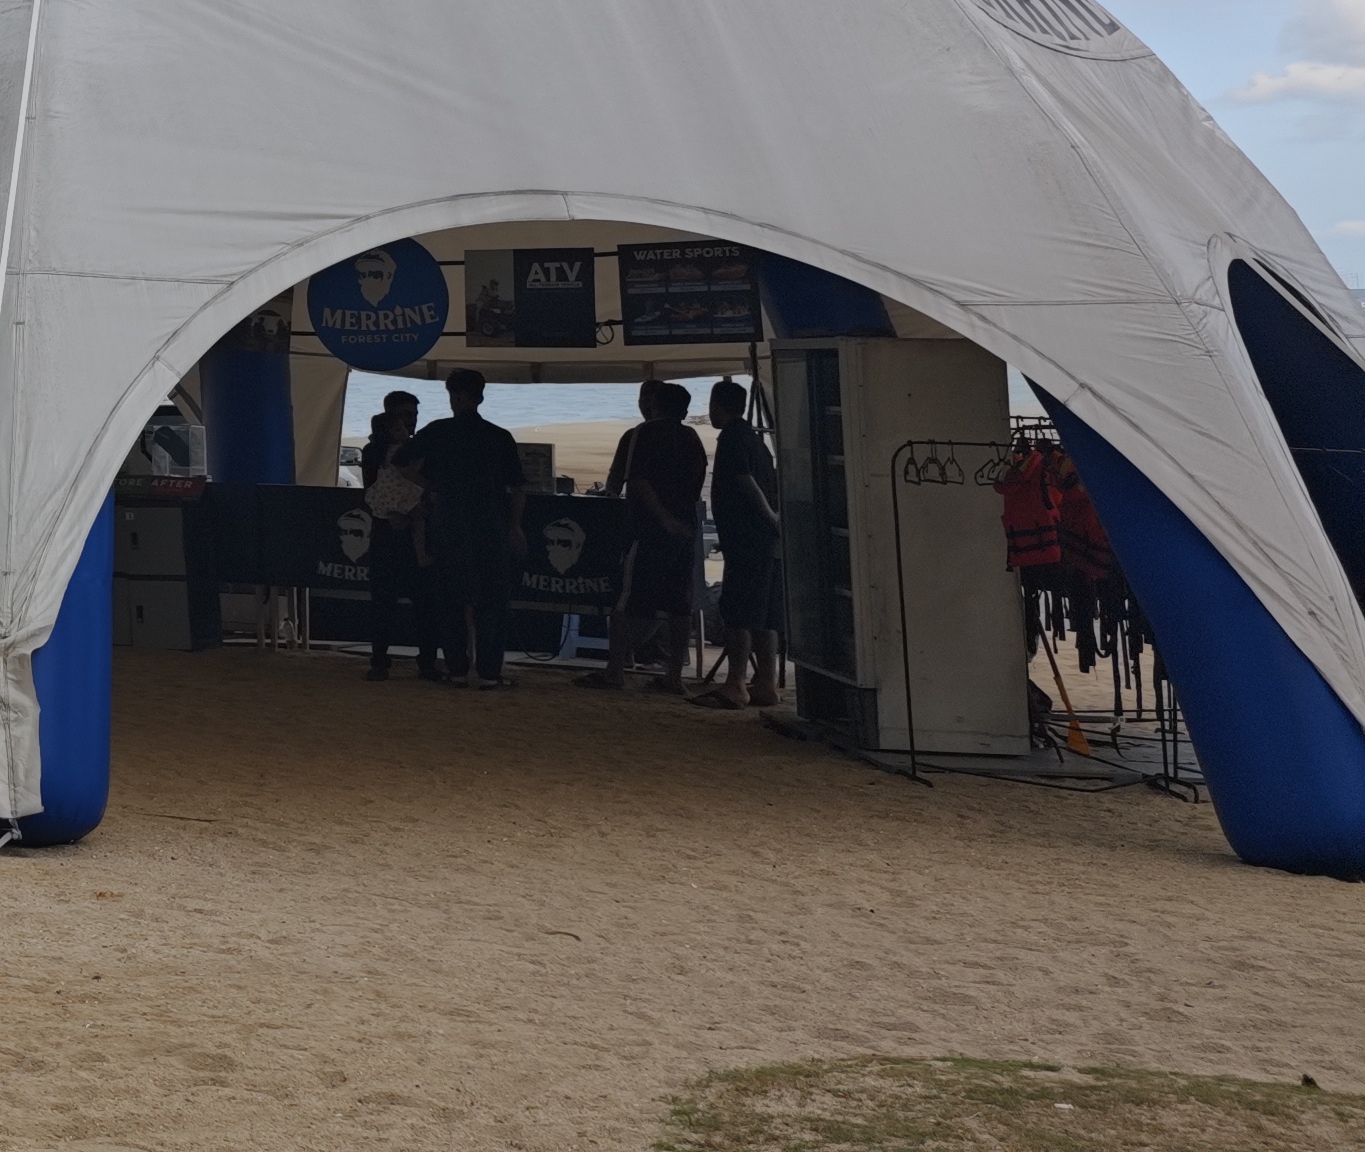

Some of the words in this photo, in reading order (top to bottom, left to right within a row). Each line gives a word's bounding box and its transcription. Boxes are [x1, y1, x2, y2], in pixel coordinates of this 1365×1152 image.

[633, 248, 682, 261] WATER
[684, 246, 740, 259] SPORTS
[527, 261, 582, 283] ATV
[341, 334, 388, 344] FOREST
[392, 332, 420, 343] CITY
[150, 478, 194, 489] AFTER
